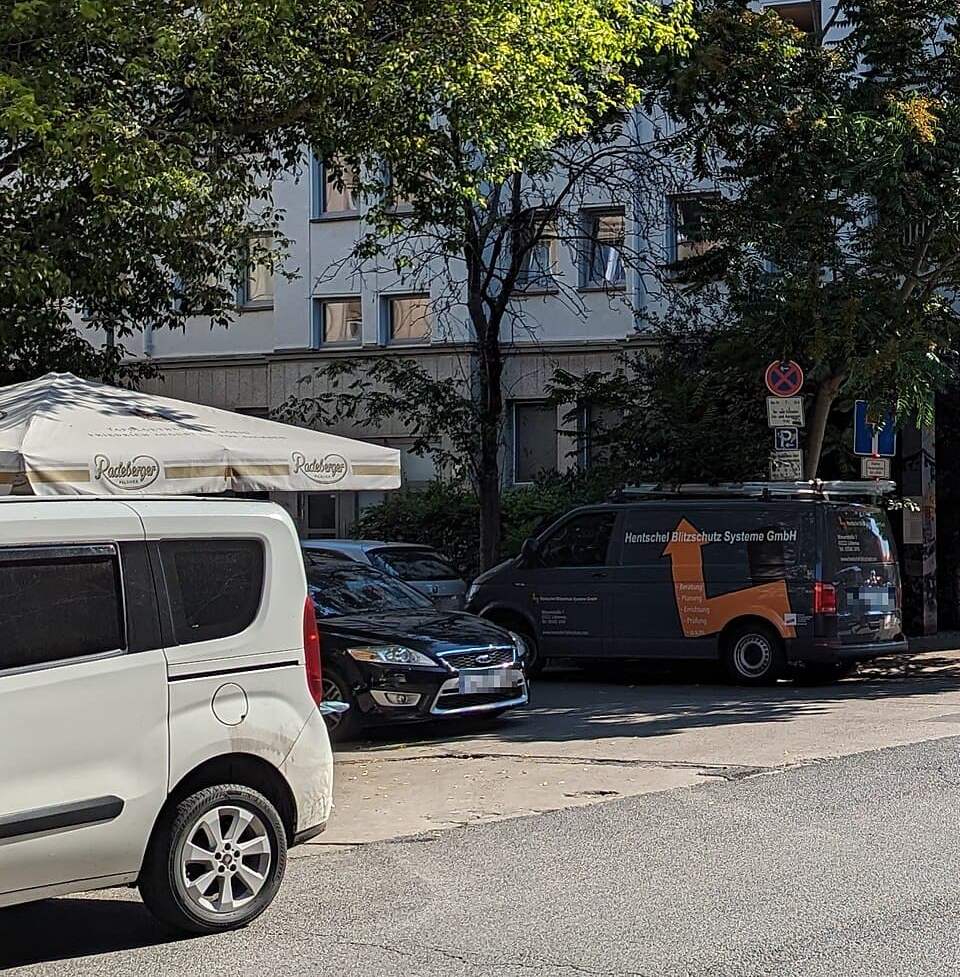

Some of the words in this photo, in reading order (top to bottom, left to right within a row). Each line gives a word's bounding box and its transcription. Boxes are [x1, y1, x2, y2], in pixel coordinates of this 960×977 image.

[94, 454, 158, 483] Radeberger
[292, 451, 346, 478] Radeberger
[625, 531, 670, 543] Hentschel
[671, 531, 722, 543] Blitzschutz
[724, 531, 764, 544] Systeme
[766, 530, 798, 542] GmbH
[679, 583, 703, 591] Beratung
